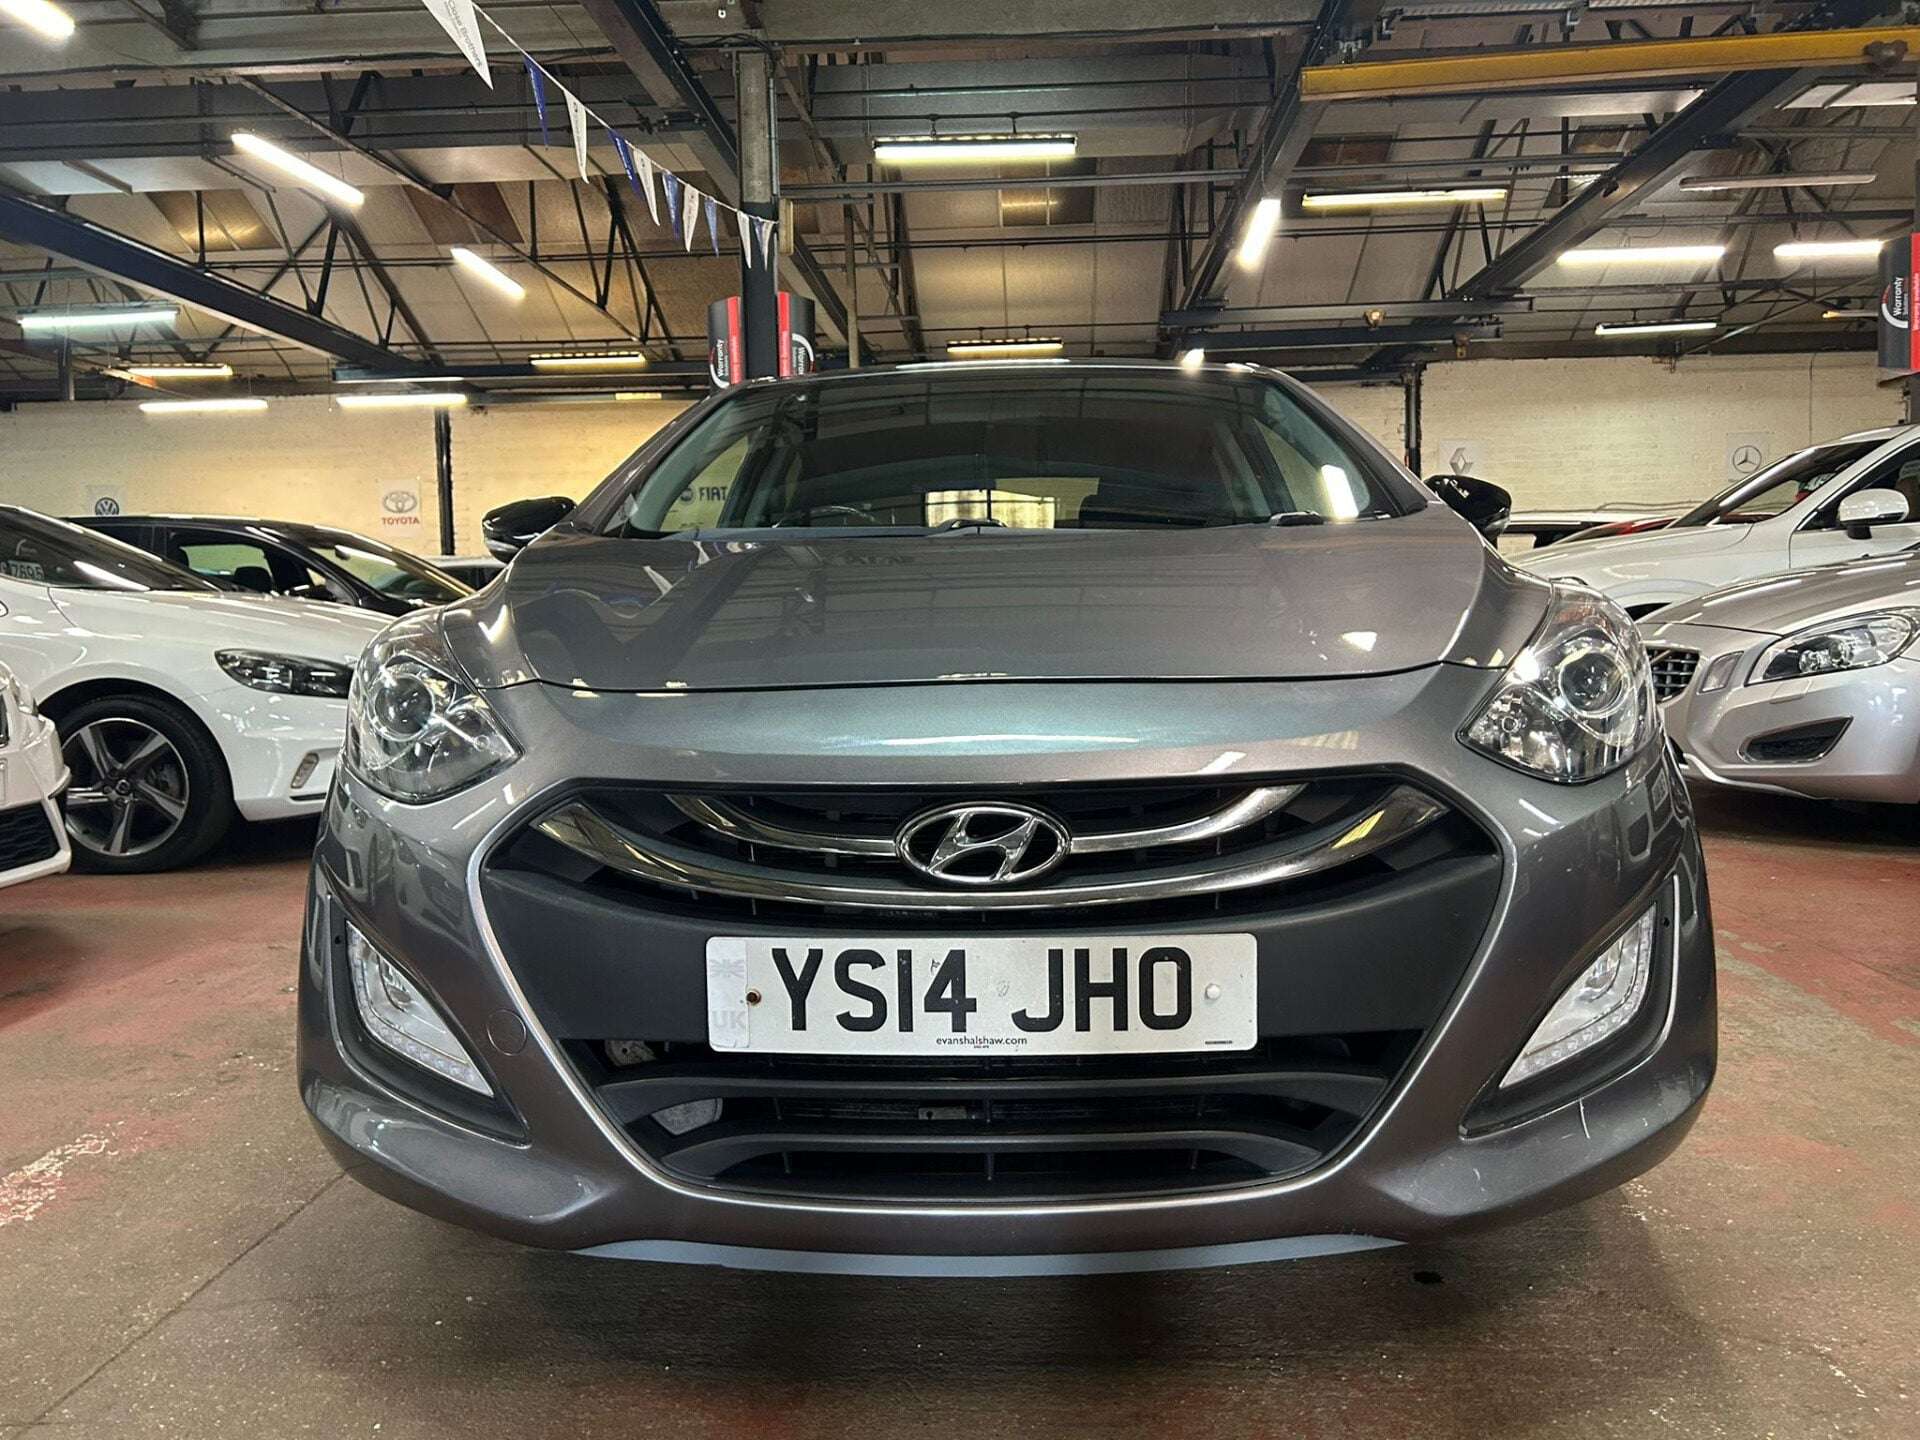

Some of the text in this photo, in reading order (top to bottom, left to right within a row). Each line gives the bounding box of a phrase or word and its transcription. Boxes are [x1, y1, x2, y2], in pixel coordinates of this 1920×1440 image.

[460, 27, 482, 67] Brothers
[1893, 277, 1904, 316] Warranty
[717, 339, 725, 377] Warranty
[699, 486, 728, 501] FIAT
[381, 516, 421, 525] TOYOTA
[771, 947, 1192, 1032] YS14 JHO
[711, 1010, 747, 1029] UK
[935, 1036, 1028, 1045] evanshalshaw.com
